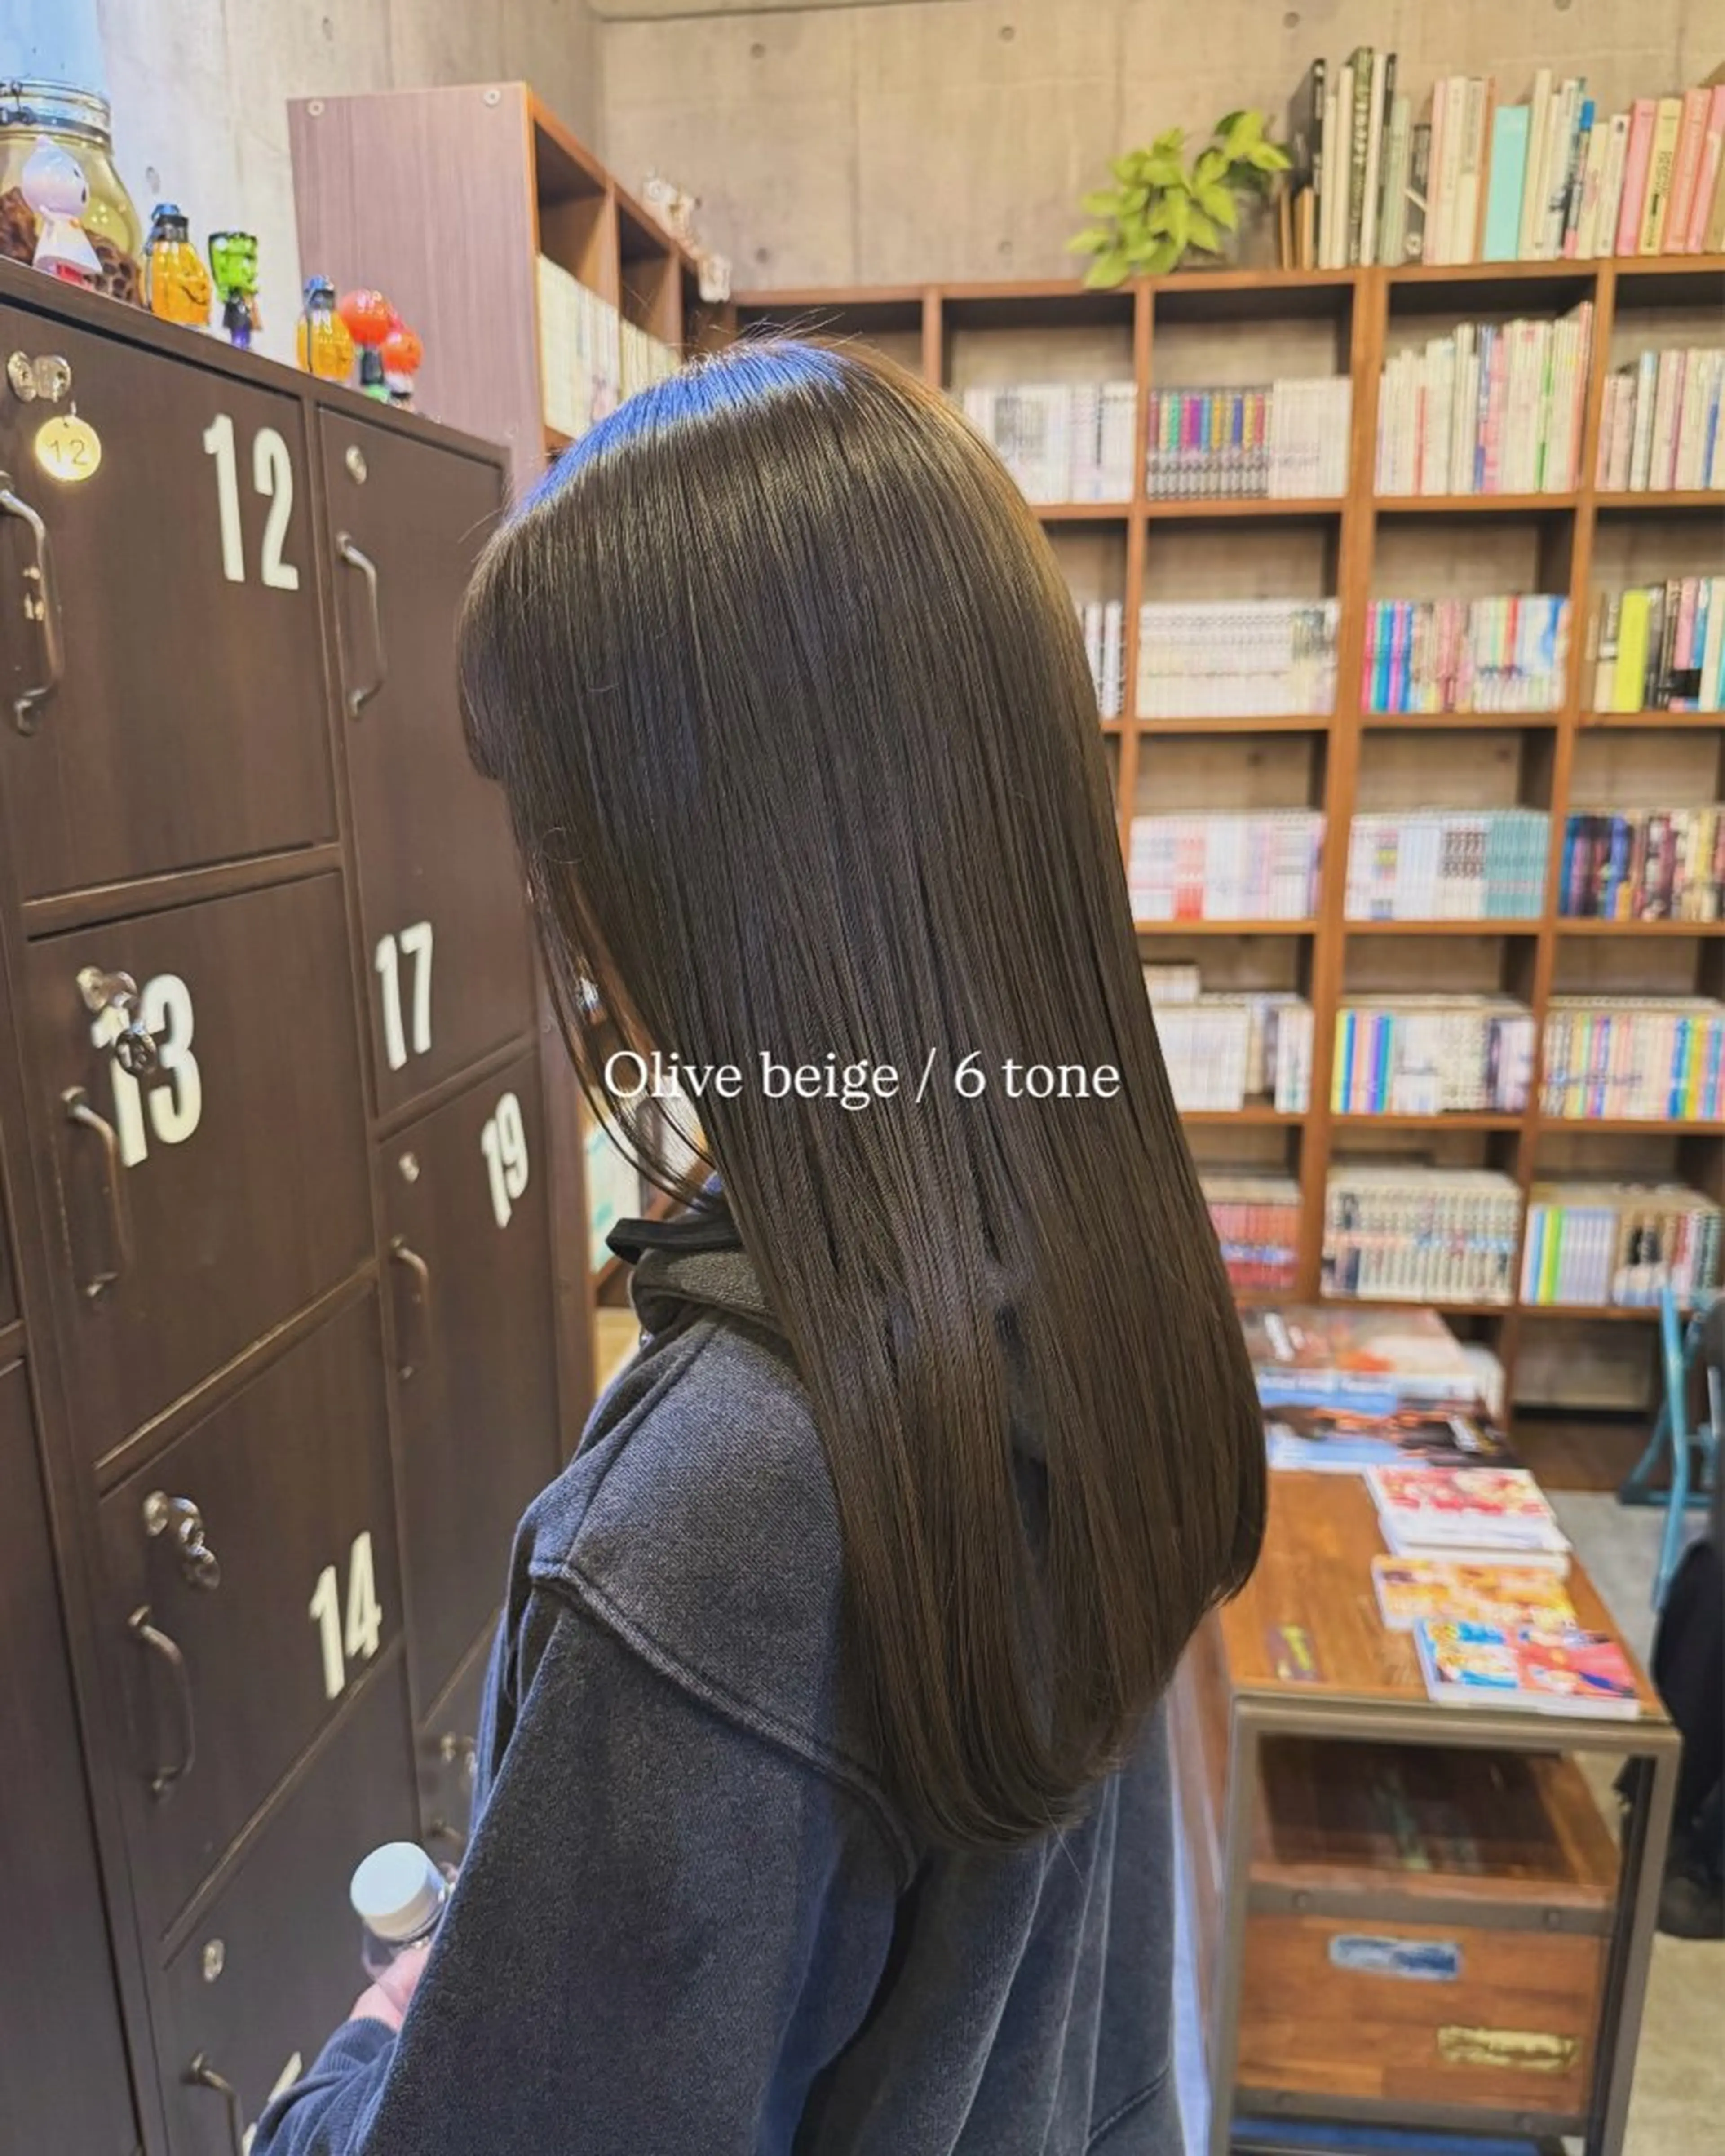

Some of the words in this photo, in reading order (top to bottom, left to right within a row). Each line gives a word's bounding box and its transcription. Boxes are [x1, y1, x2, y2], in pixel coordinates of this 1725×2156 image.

[48, 439, 88, 466] 12
[203, 414, 299, 590] 12
[92, 974, 202, 1167] 13
[376, 921, 433, 1070] 17
[481, 1092, 529, 1229] 19
[309, 1530, 383, 1700] 14
